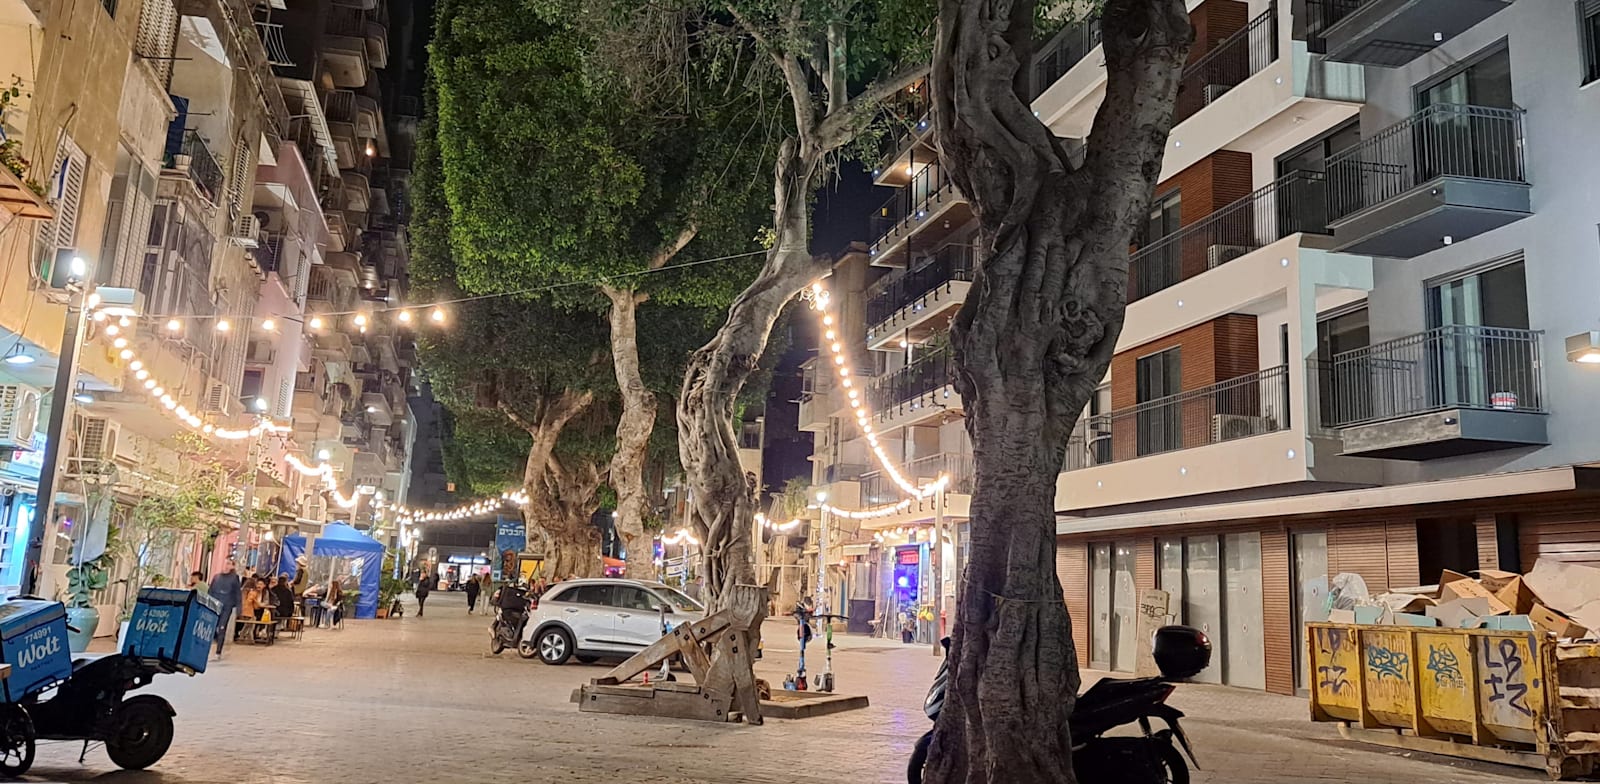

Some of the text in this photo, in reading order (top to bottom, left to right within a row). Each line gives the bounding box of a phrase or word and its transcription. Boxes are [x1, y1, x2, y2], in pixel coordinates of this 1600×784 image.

[23, 625, 52, 645] 774991
[136, 618, 168, 633] Wolt
[17, 635, 61, 668] Wolt
